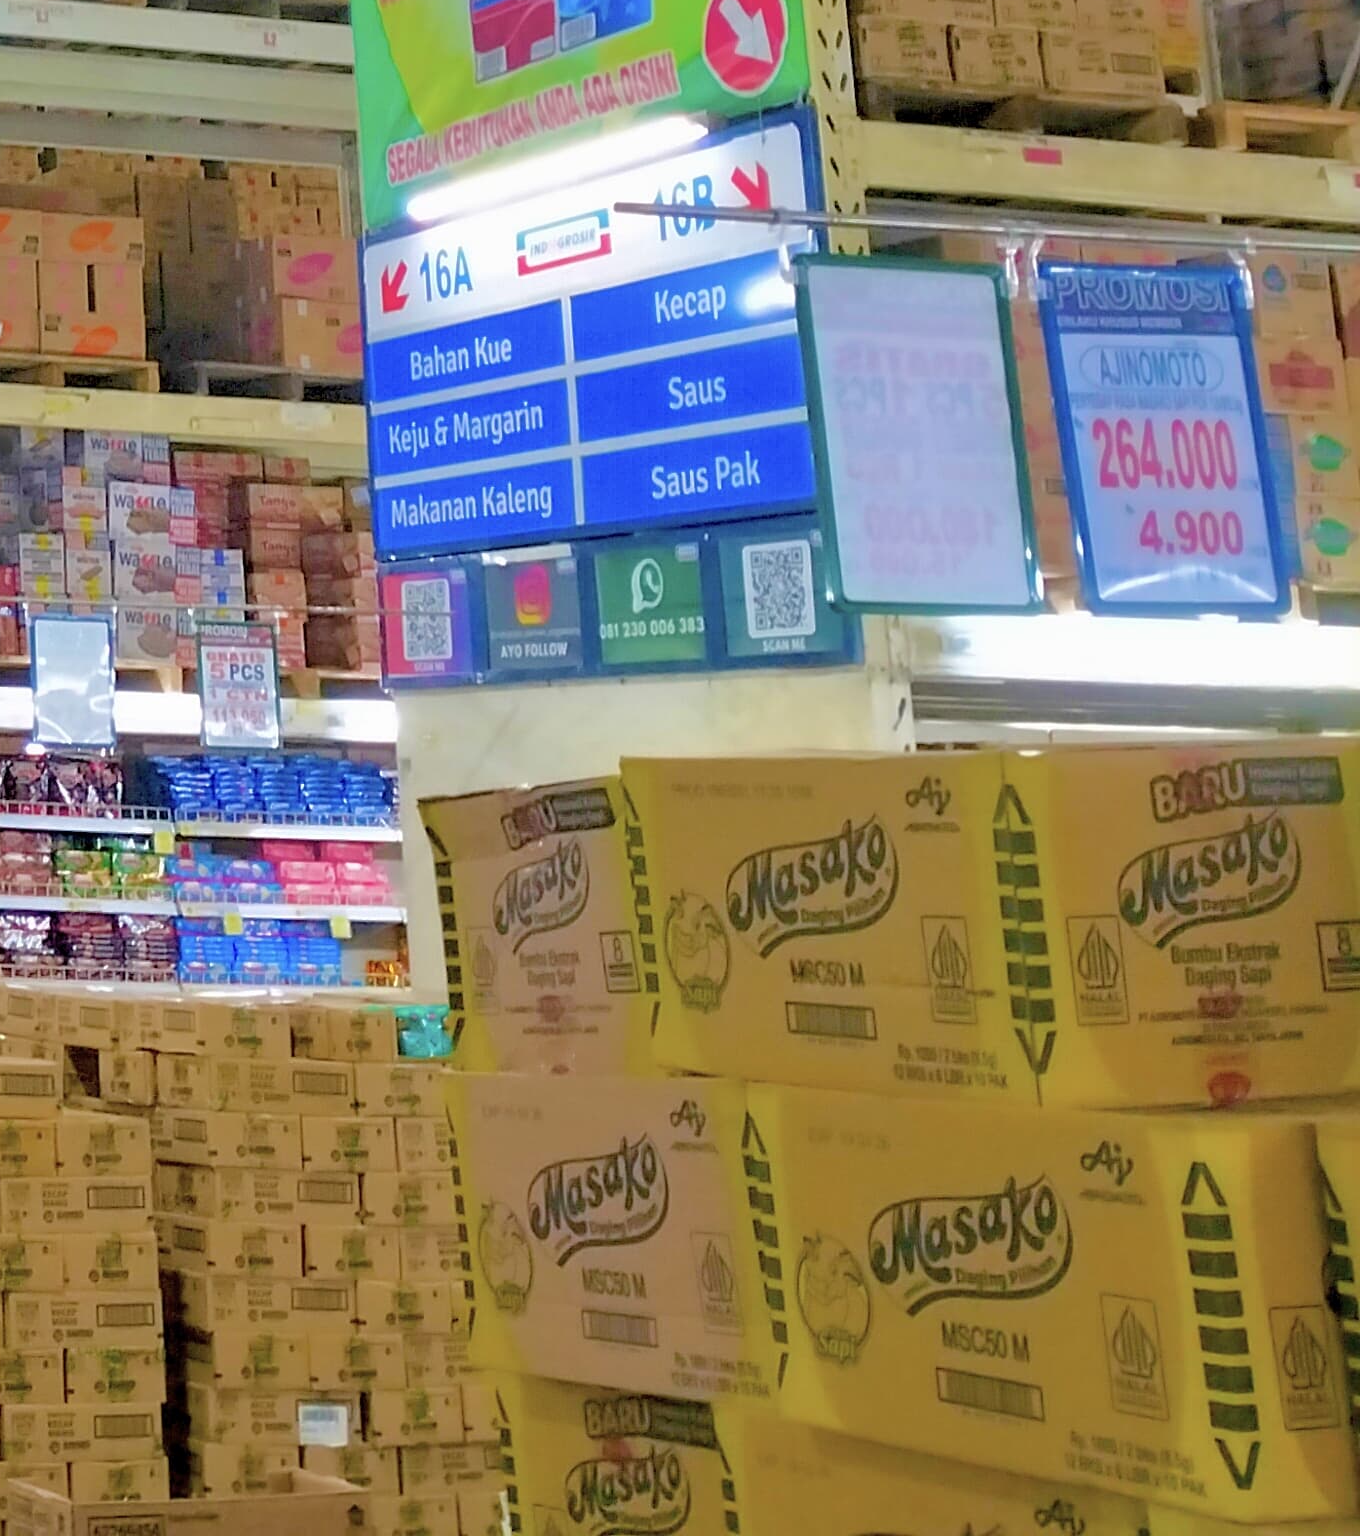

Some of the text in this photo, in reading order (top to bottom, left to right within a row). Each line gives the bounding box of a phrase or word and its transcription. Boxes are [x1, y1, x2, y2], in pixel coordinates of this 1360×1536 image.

[654, 174, 717, 243] 16B
[418, 245, 473, 304] 16A
[1053, 276, 1230, 313] PROMOSI
[655, 284, 728, 325] Kecap
[409, 335, 513, 382] Bahan Kue
[1099, 352, 1208, 388] AJINOMOTO
[668, 374, 728, 411] Saus
[388, 400, 544, 459] Keju & Margarin
[1092, 417, 1238, 491] 264.000
[651, 450, 762, 501] Saus Pak
[390, 481, 554, 530] Makanan Kaleng
[1139, 510, 1245, 557] 4.900
[500, 639, 568, 661] AYO FOLLOW
[622, 619, 647, 638] 230
[650, 617, 676, 637] 006
[678, 614, 705, 635] 383
[229, 663, 265, 681] PCS
[493, 837, 583, 936] Masako
[729, 818, 887, 933] Masako
[1120, 813, 1289, 926] Masako
[530, 1135, 657, 1241] Masako
[871, 1174, 1059, 1286] Masako
[941, 1319, 1031, 1363] MSC50 M
[566, 1443, 682, 1525] Masako
